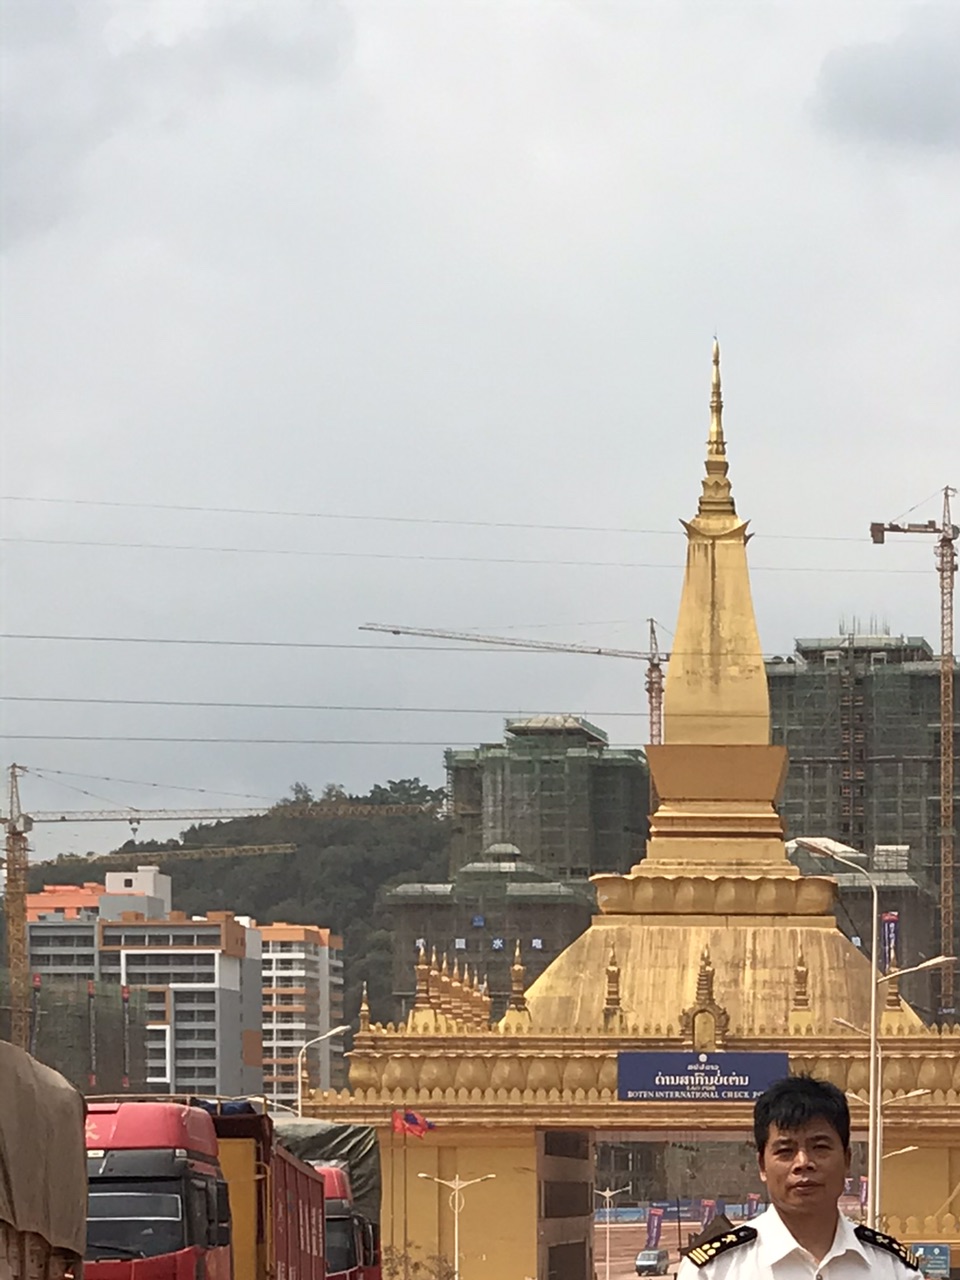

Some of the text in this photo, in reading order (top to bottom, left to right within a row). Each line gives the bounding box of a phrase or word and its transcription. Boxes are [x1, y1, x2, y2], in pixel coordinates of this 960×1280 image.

[627, 1090, 655, 1099] BOTEN
[655, 1090, 719, 1099] INTERNATIONAL
[722, 1090, 749, 1099] CHECK
